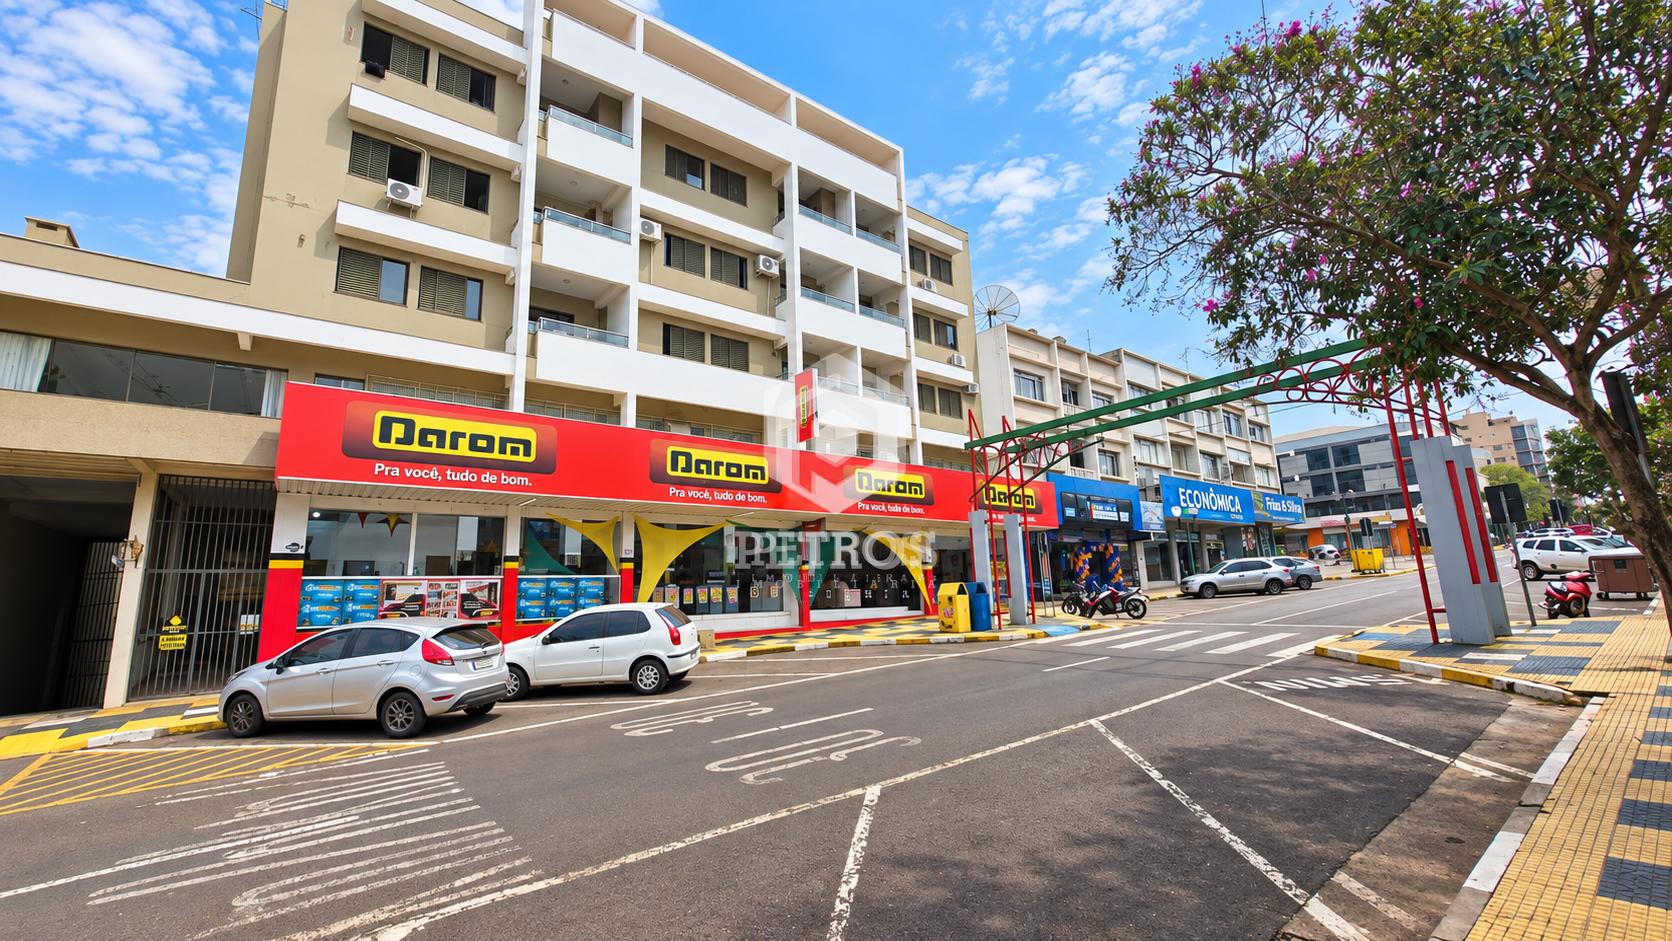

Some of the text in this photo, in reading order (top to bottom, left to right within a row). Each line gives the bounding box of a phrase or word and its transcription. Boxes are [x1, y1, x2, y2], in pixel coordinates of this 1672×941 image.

[378, 415, 532, 457] Darom
[374, 463, 532, 486] Pra você, tudo de bom.
[670, 450, 766, 480] Darom
[669, 487, 767, 503] Pra você, tudo de bom.
[857, 471, 923, 496] Darom
[1178, 487, 1242, 513] ECONÔMICA
